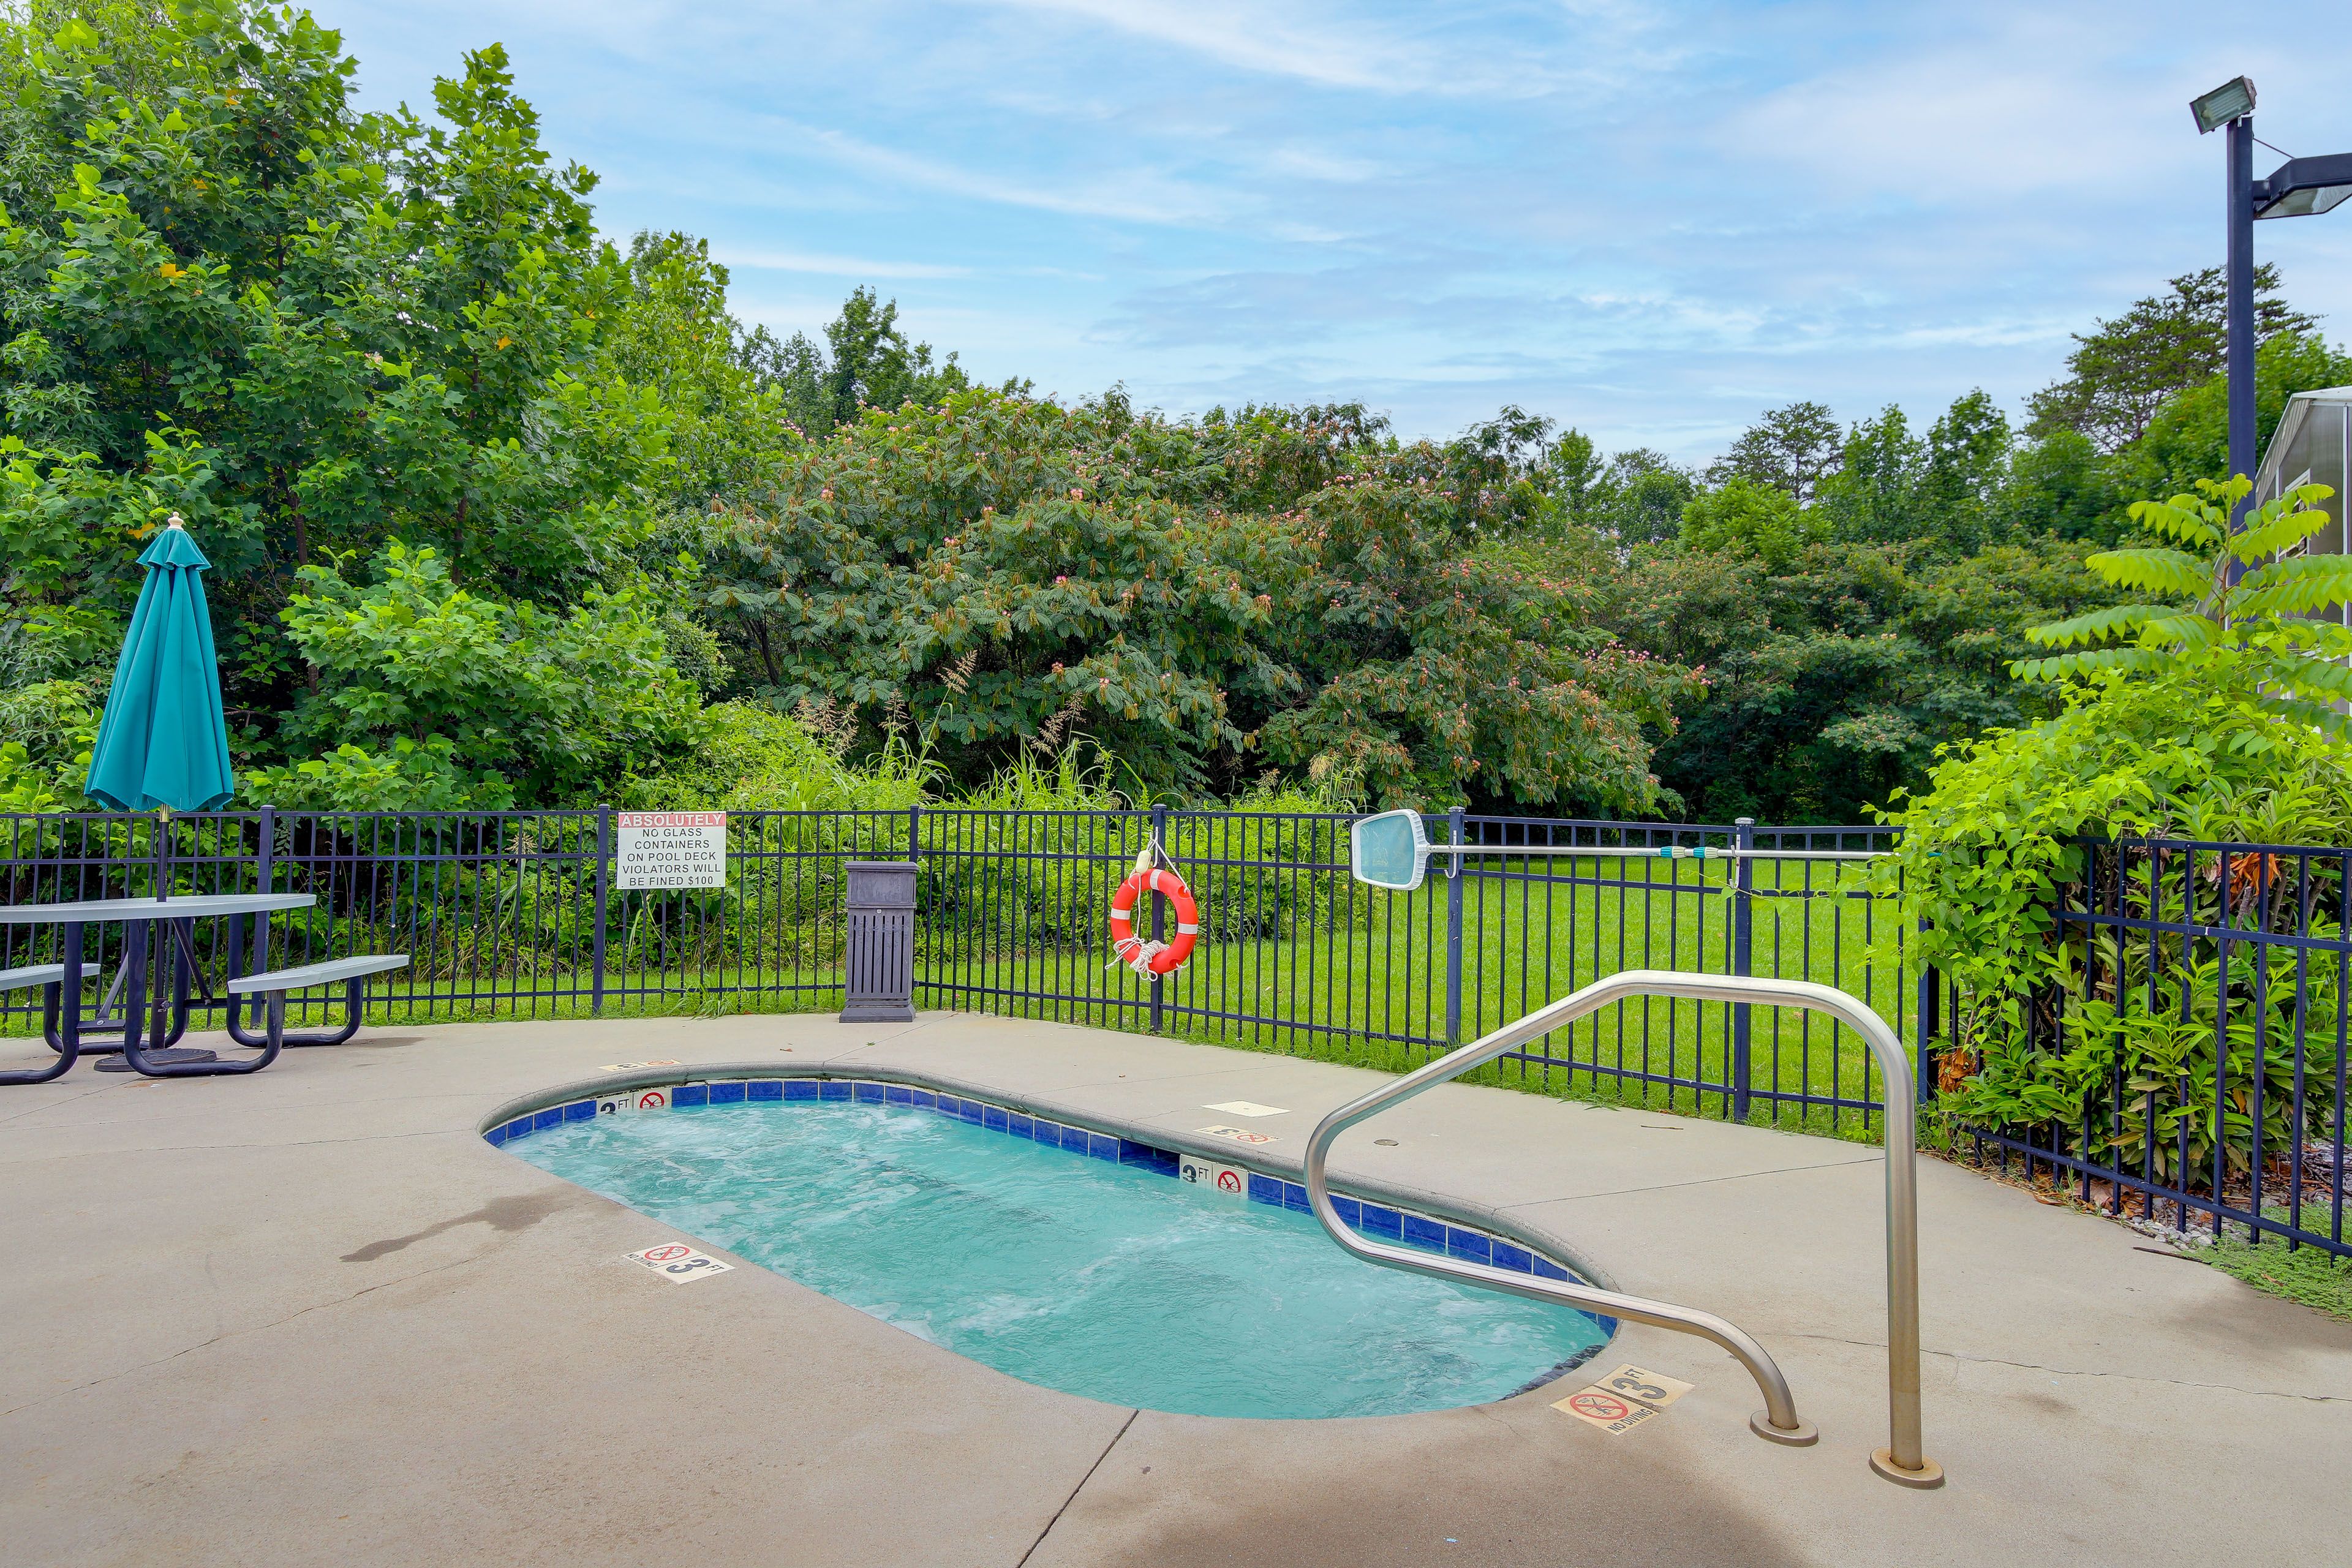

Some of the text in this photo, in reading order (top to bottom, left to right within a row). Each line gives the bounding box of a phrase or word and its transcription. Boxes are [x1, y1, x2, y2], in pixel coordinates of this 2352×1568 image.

[621, 814, 722, 826] ABSOLUTELY
[663, 828, 702, 837] GLASS
[635, 840, 709, 850] CONTAINERS
[627, 853, 643, 862] ON
[685, 852, 716, 861] DECK
[622, 864, 720, 874] VIOLATORS WILL
[649, 876, 684, 886] FINED
[688, 876, 713, 886] $100
[618, 1099, 629, 1109] FT
[1182, 1164, 1209, 1183] 3 FT
[666, 1259, 710, 1273] 3
[1611, 1368, 1667, 1400] 3 FT
[1607, 1408, 1654, 1432] NO DIVING
